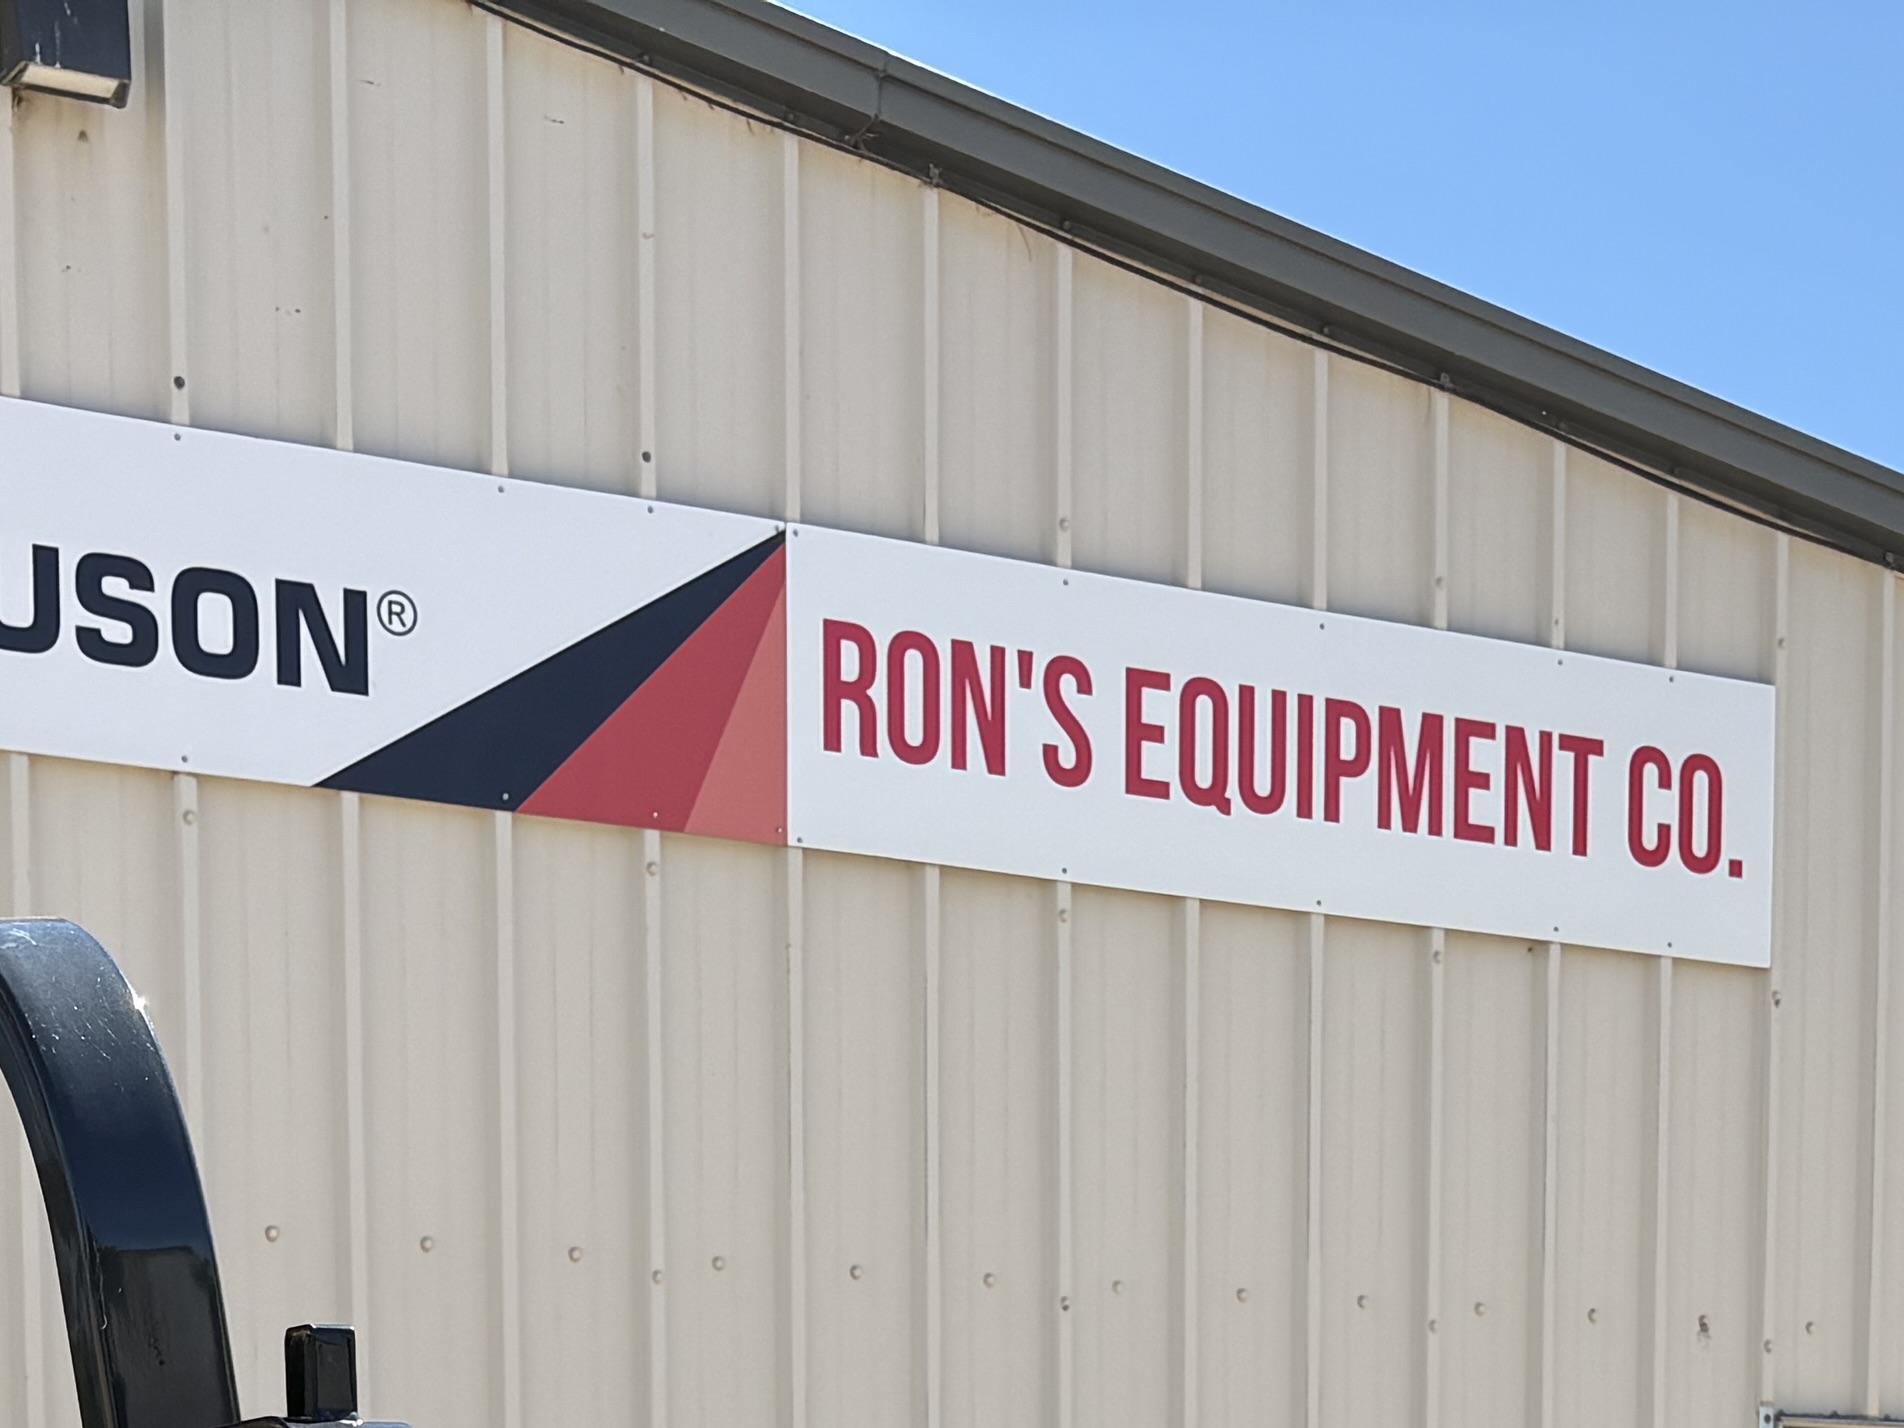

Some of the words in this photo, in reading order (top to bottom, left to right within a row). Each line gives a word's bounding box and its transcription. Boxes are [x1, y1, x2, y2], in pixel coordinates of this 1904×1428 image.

[822, 618, 1094, 789] RON'S
[1124, 667, 1604, 857] EQUIPMENT
[1627, 745, 1744, 879] CO.
